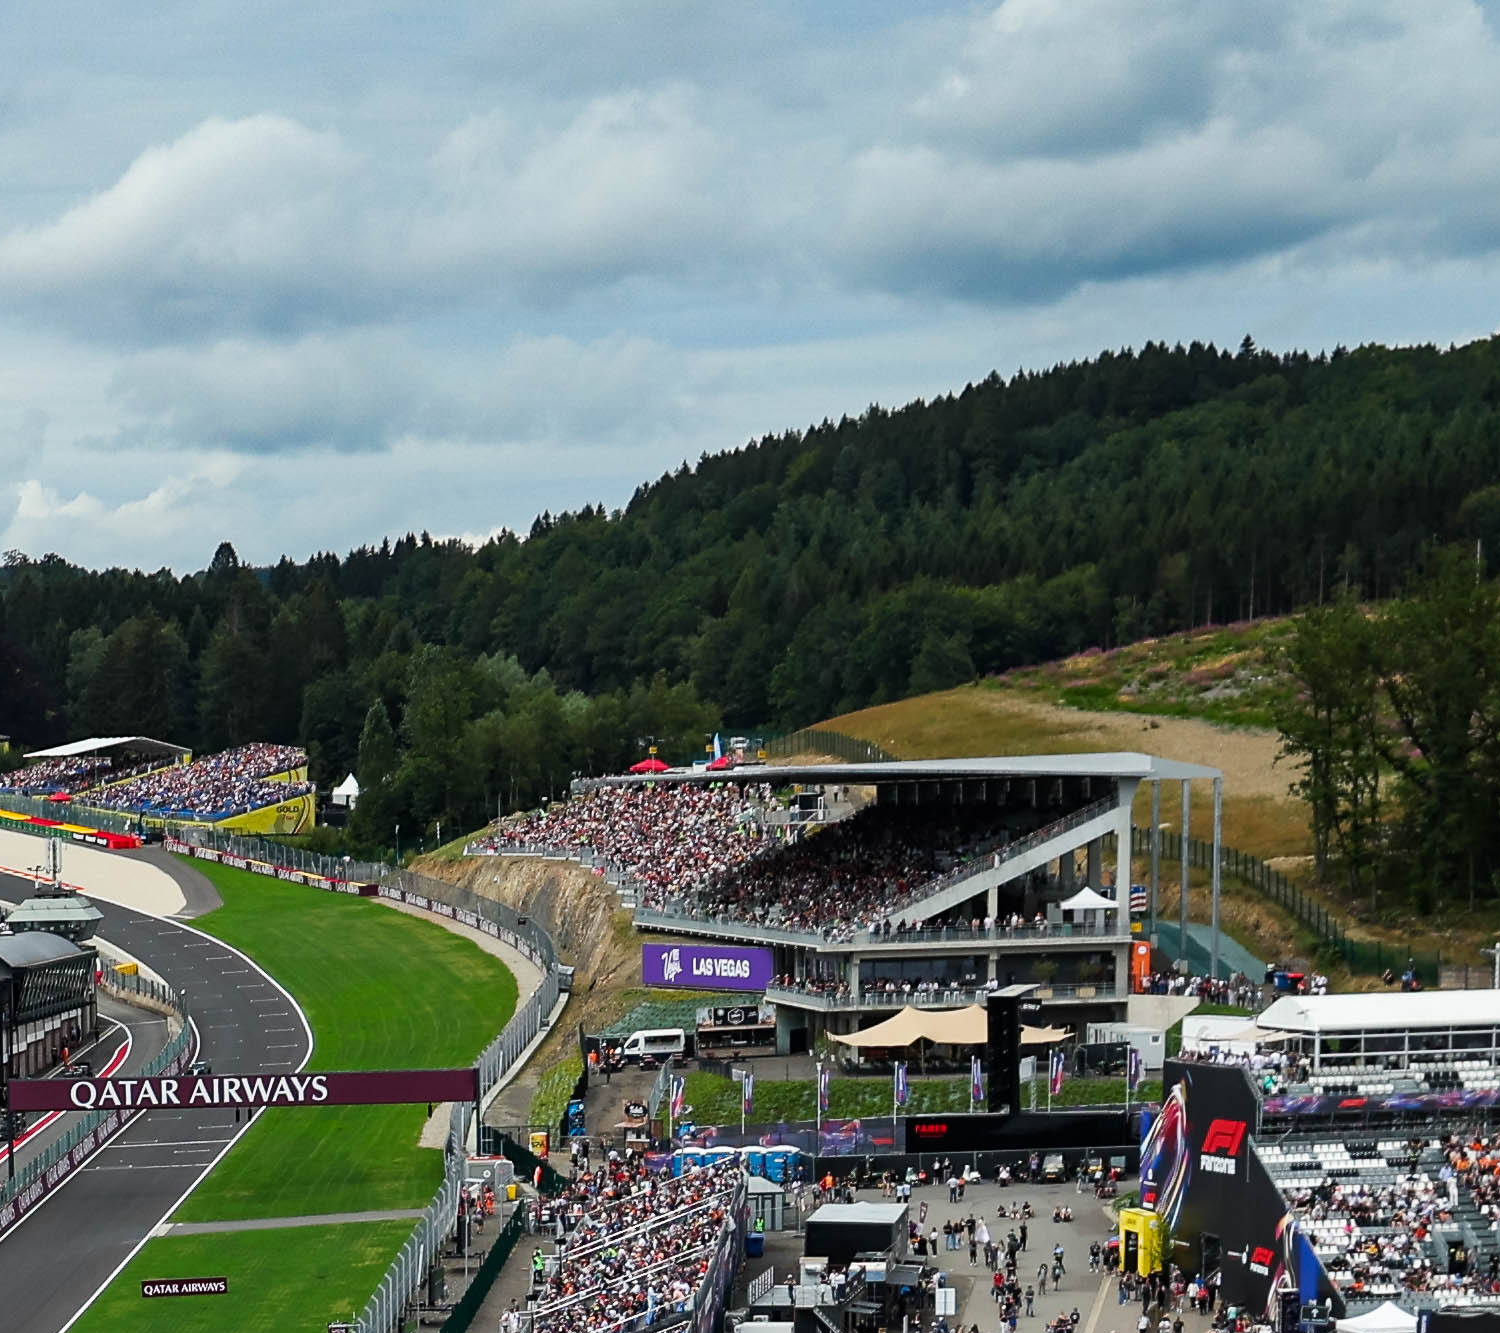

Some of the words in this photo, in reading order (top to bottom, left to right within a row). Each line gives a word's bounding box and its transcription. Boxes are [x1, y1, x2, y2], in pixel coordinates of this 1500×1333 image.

[692, 957, 713, 976] LAS
[714, 958, 750, 978] VEGAS
[69, 1079, 181, 1109] QATAR
[189, 1075, 328, 1105] AIRWAYS
[144, 1283, 179, 1297] QATAR
[181, 1281, 226, 1294] AIRWAYS
